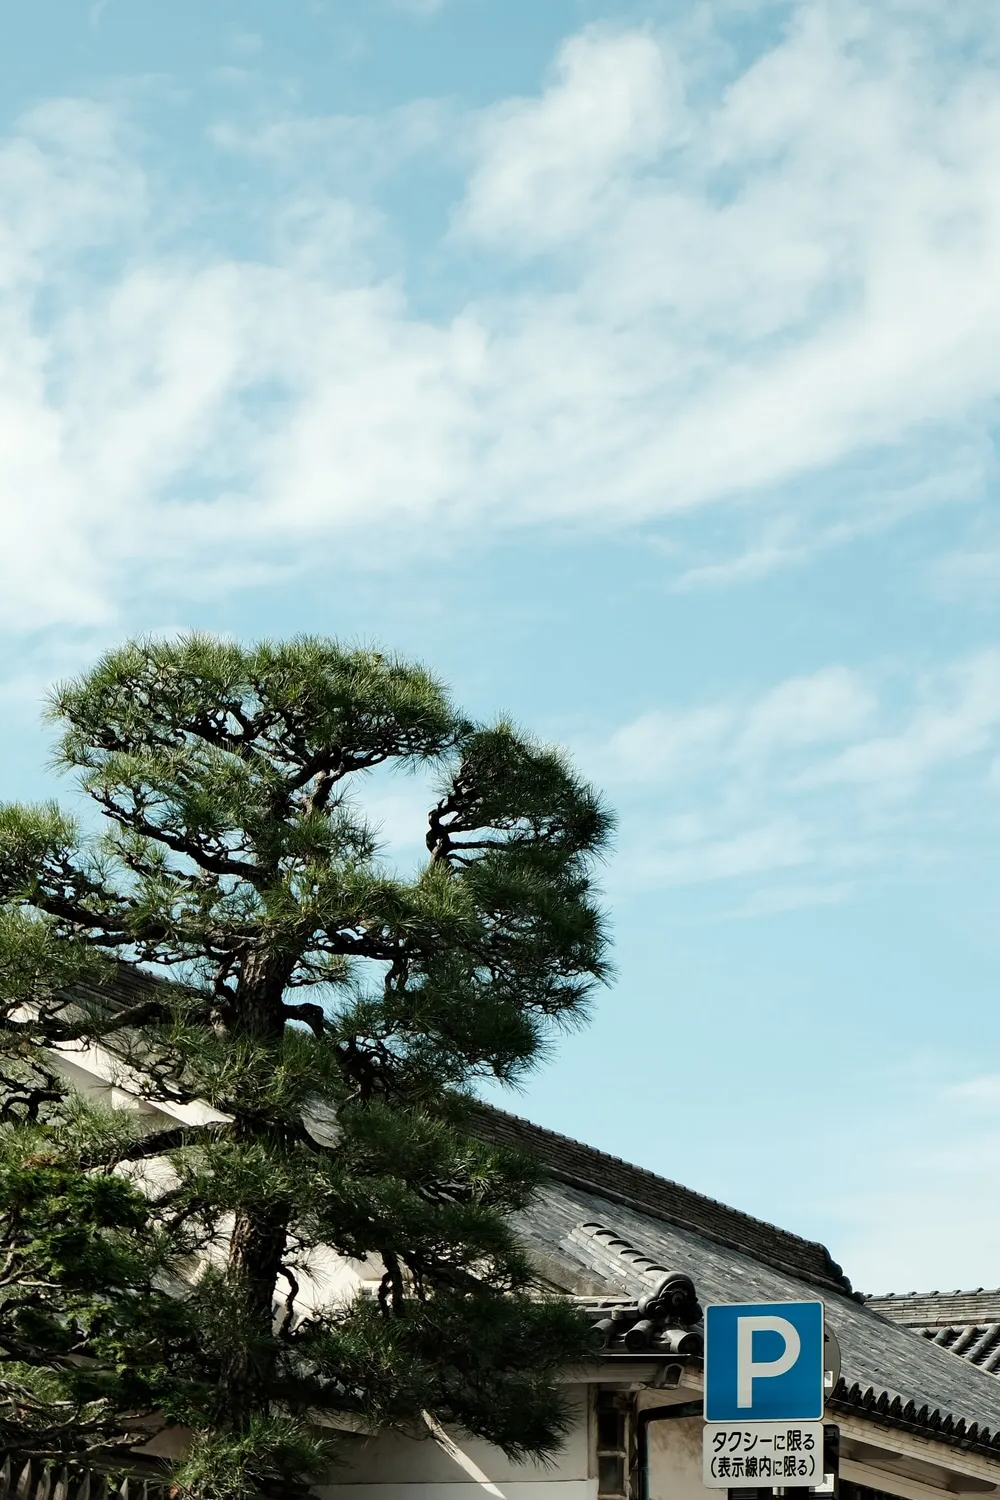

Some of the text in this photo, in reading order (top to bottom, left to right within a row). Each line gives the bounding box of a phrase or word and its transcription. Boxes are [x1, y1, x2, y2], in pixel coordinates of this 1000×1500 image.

[737, 1315, 801, 1409] P
[712, 1429, 815, 1452] タクシーに限る
